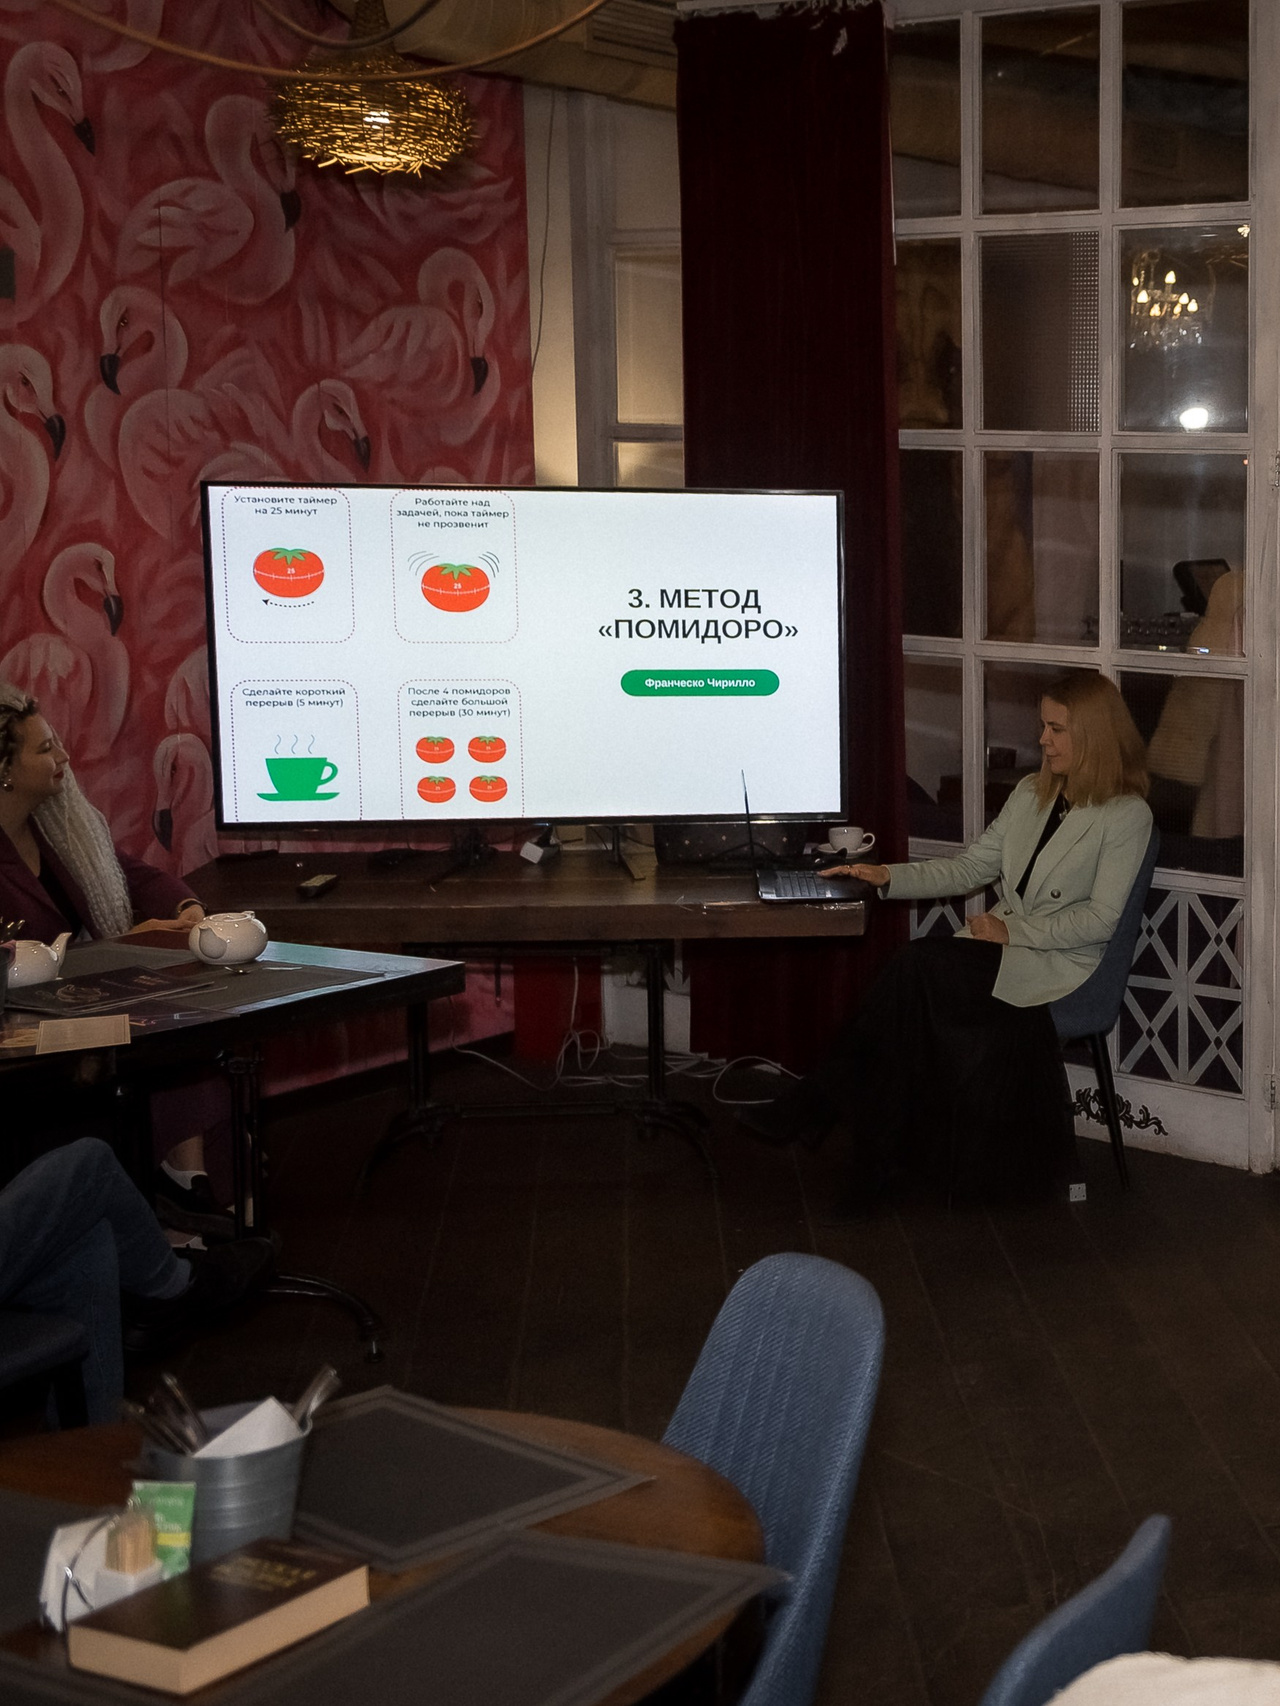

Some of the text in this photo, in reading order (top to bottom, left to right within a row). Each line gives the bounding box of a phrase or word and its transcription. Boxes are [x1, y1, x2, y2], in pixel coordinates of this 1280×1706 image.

[233, 494, 338, 506] Установите таймер
[414, 496, 491, 508] Работайте над
[254, 506, 318, 517] на 25 минут
[396, 509, 510, 519] задачей, пока таймер
[417, 520, 489, 530] не прозвенит
[627, 588, 762, 614] 3. МЕТОД
[598, 618, 799, 645] «ПОМИДОРО»
[644, 678, 756, 690] Франческо Чирилло
[241, 687, 346, 698] Сделайте короткий
[407, 687, 511, 697] После 4 помидоров
[245, 698, 344, 709] перерыв (5 минут)
[411, 697, 508, 708] сделайте большой
[409, 708, 511, 719] перерыв (30 минут)
